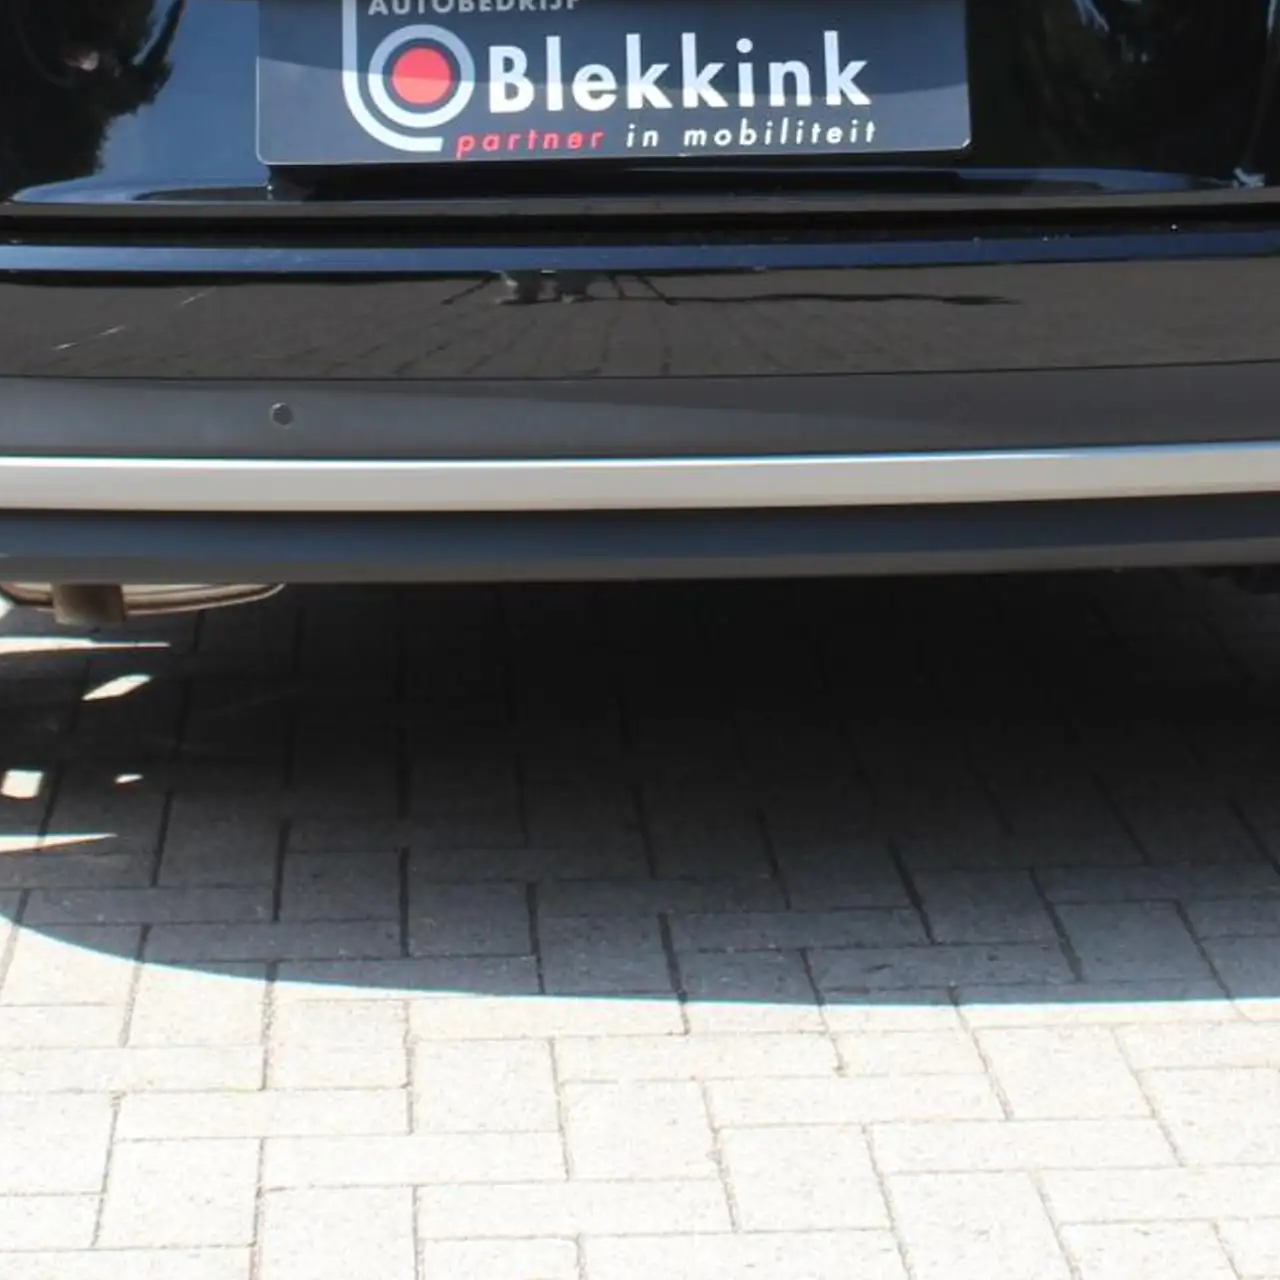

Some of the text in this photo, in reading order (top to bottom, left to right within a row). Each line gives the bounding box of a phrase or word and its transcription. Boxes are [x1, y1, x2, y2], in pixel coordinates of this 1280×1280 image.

[488, 30, 872, 113] Blekkink
[456, 117, 876, 159] partner in mobiliteit
